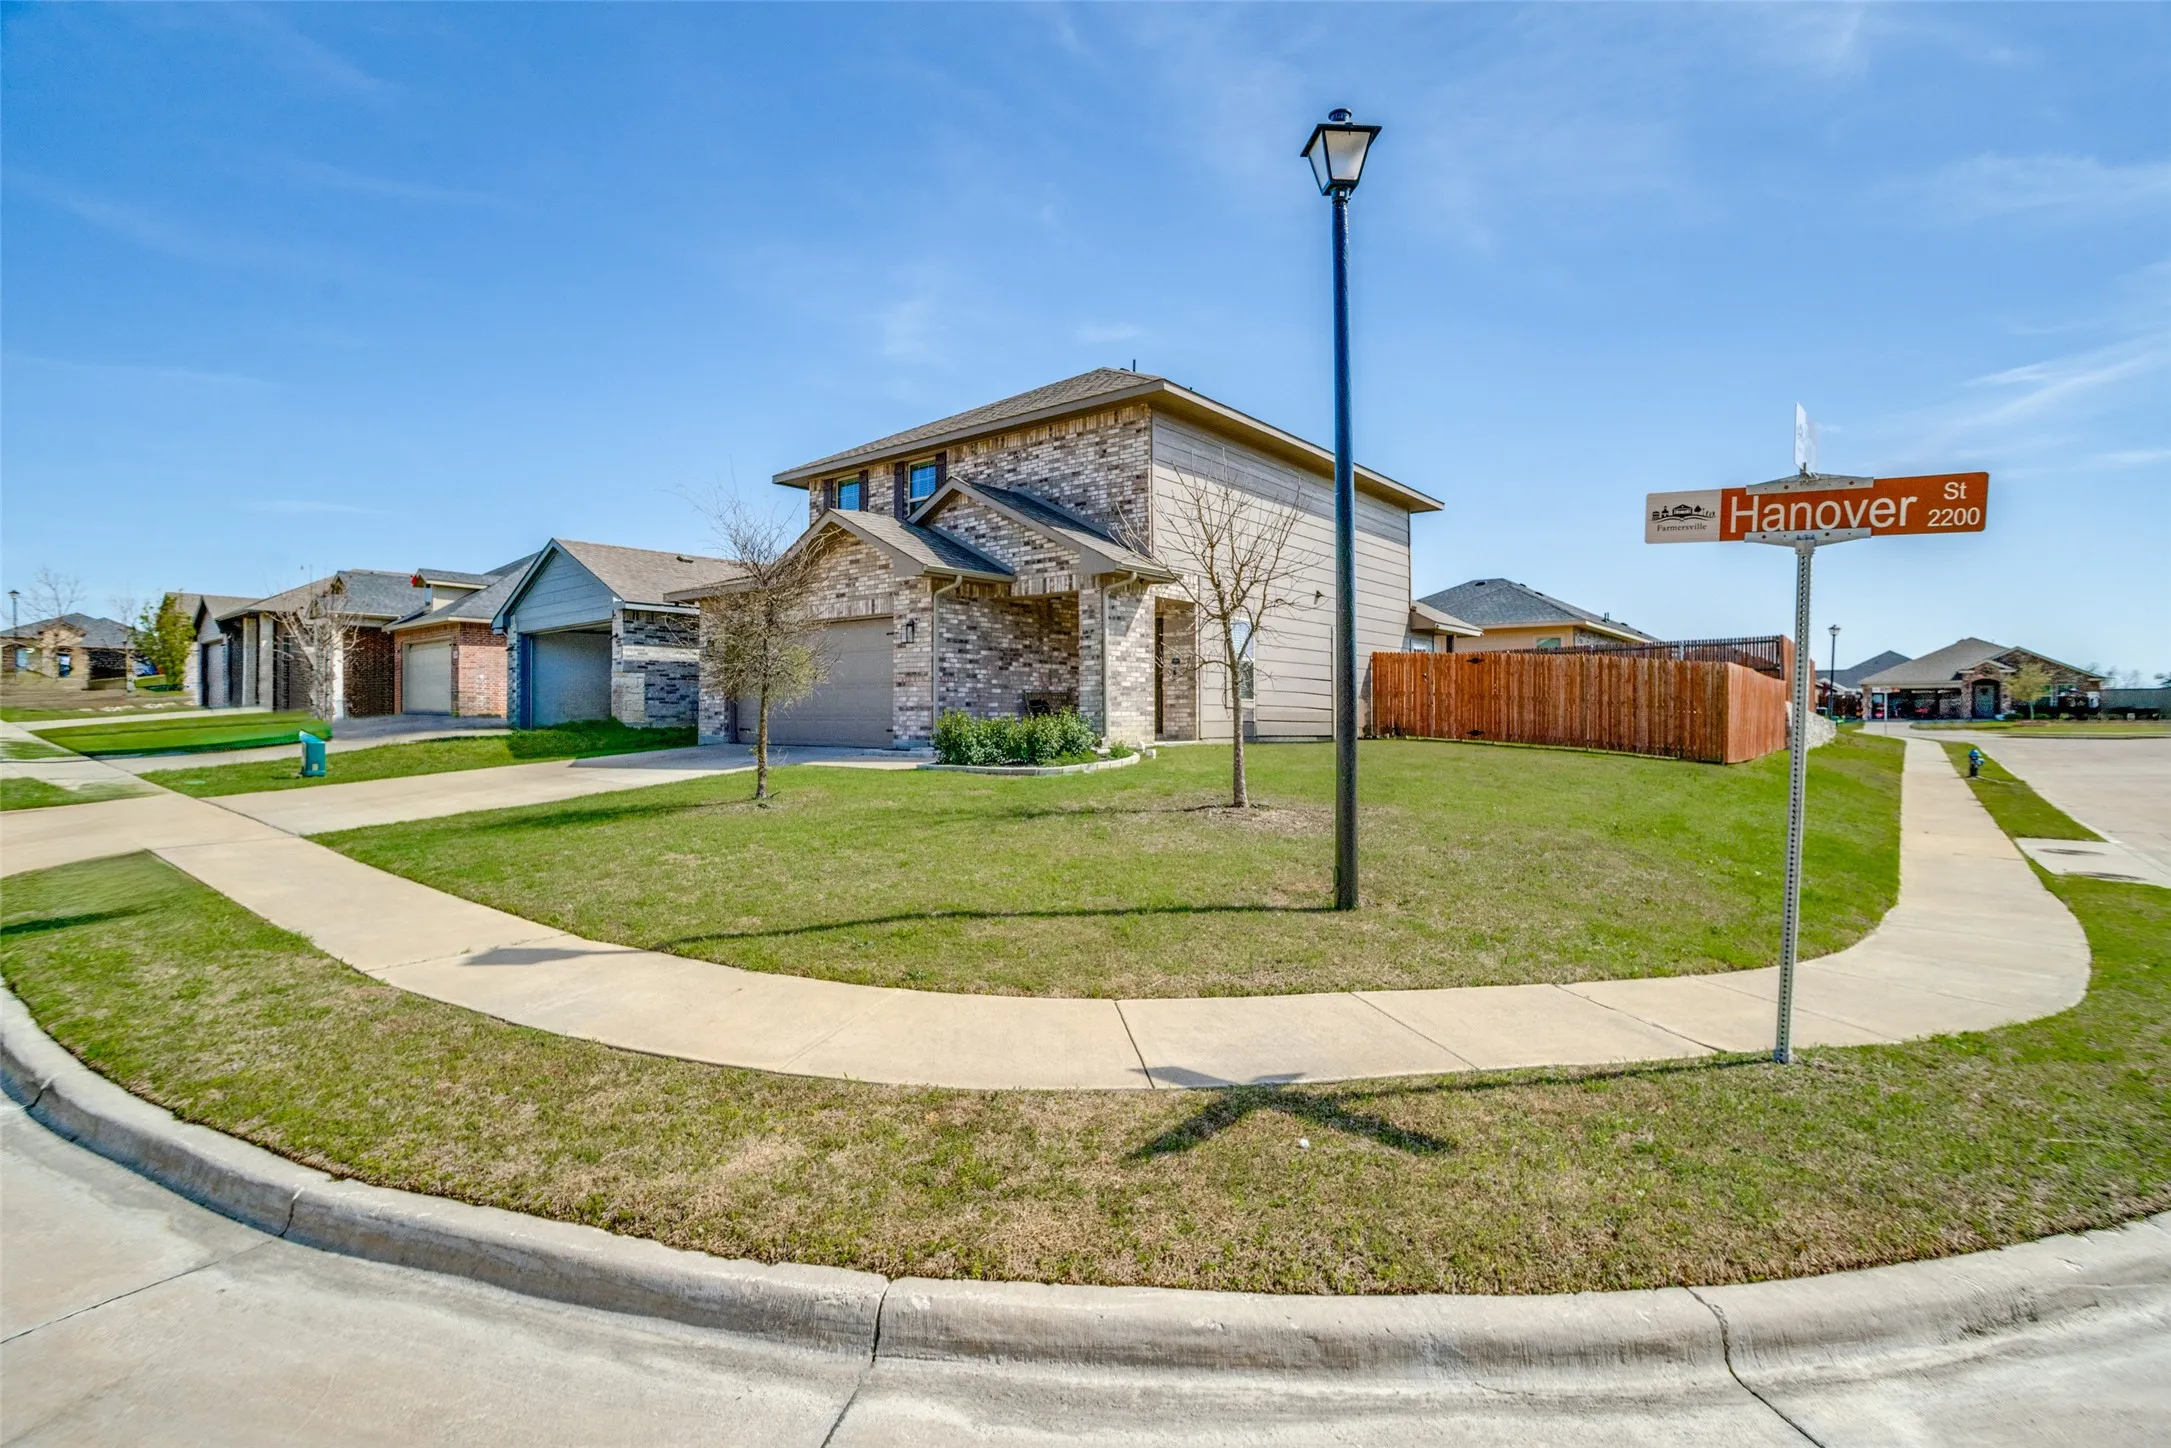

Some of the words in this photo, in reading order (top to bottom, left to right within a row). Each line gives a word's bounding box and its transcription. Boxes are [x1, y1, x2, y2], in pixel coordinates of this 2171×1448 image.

[1730, 495, 1918, 533] Hanover
[1944, 482, 1967, 500] St
[1927, 507, 1981, 528] 2200
[1656, 522, 1708, 532] Farmersville
